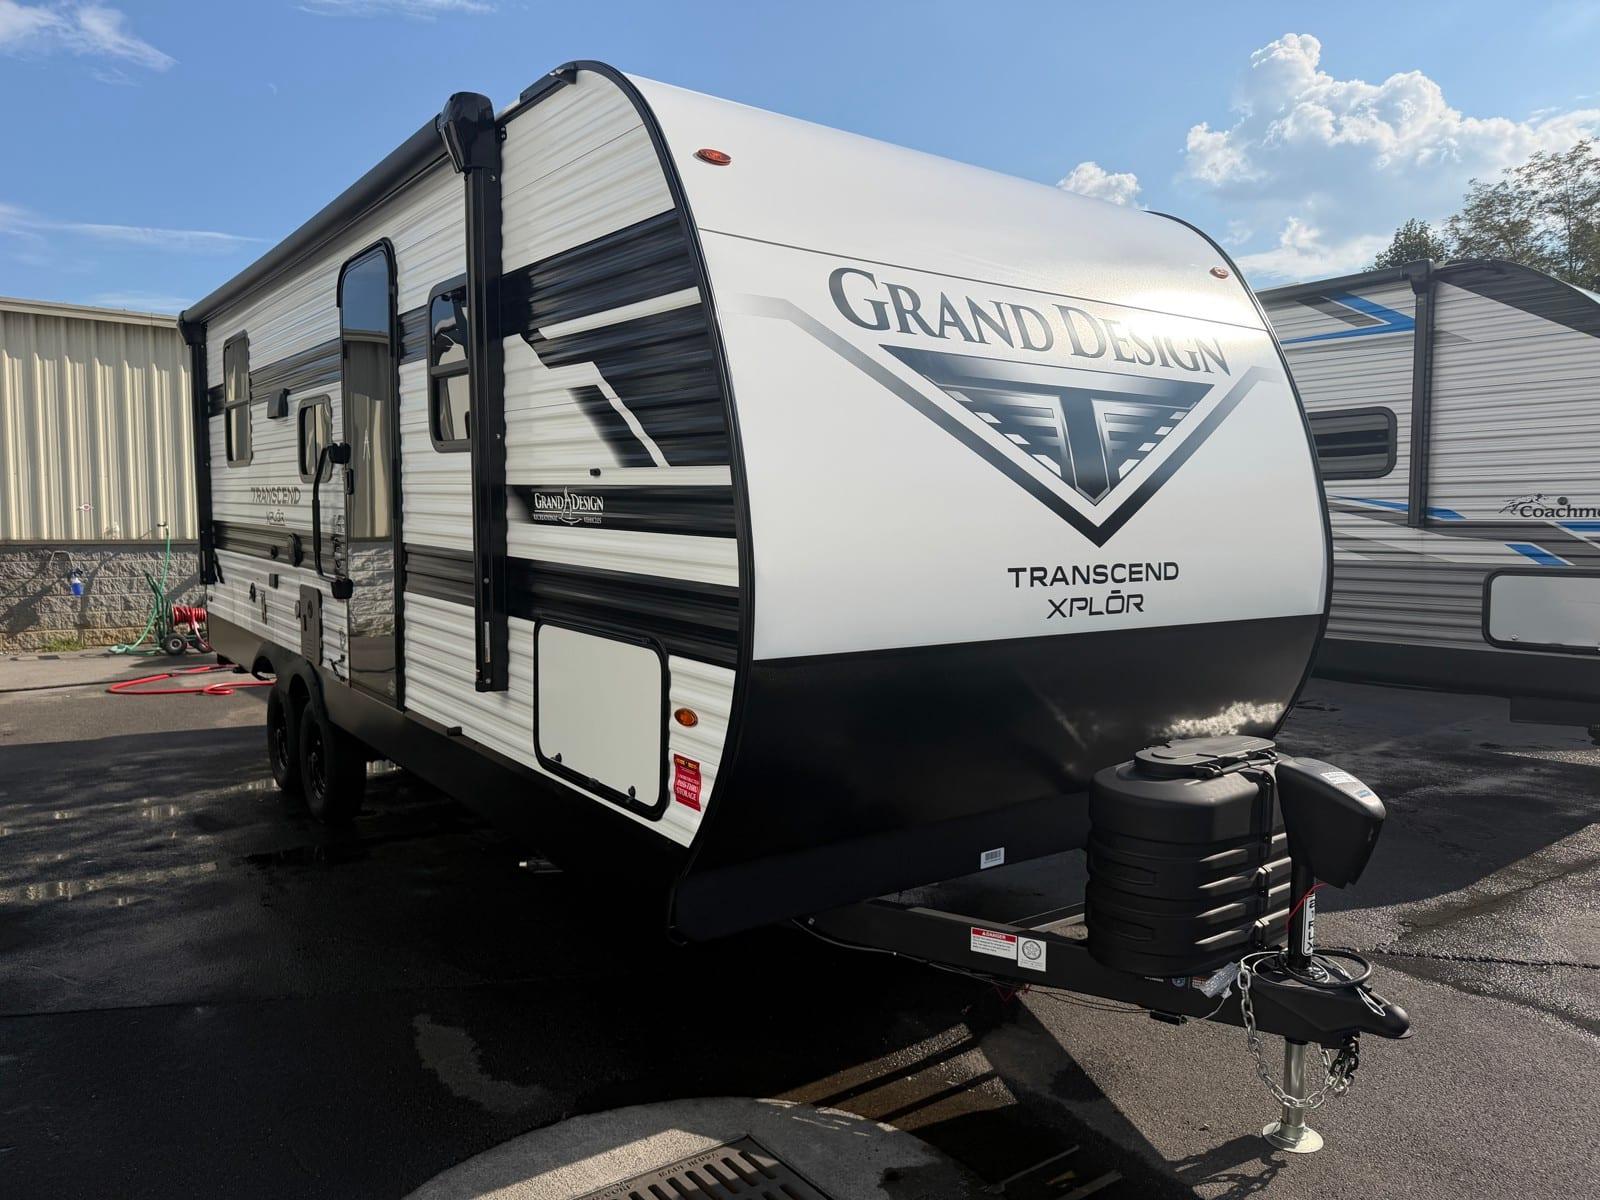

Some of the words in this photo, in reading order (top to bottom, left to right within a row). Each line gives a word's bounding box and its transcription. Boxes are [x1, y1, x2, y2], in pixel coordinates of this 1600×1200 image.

[828, 267, 1054, 353] GRAND
[1052, 303, 1231, 376] DESIGN
[250, 486, 301, 505] TRANSCEND
[534, 492, 564, 509] GRAND
[570, 493, 604, 511] DESIGN
[1520, 504, 1600, 518] Coachm
[1008, 562, 1179, 588] TRANSCEND
